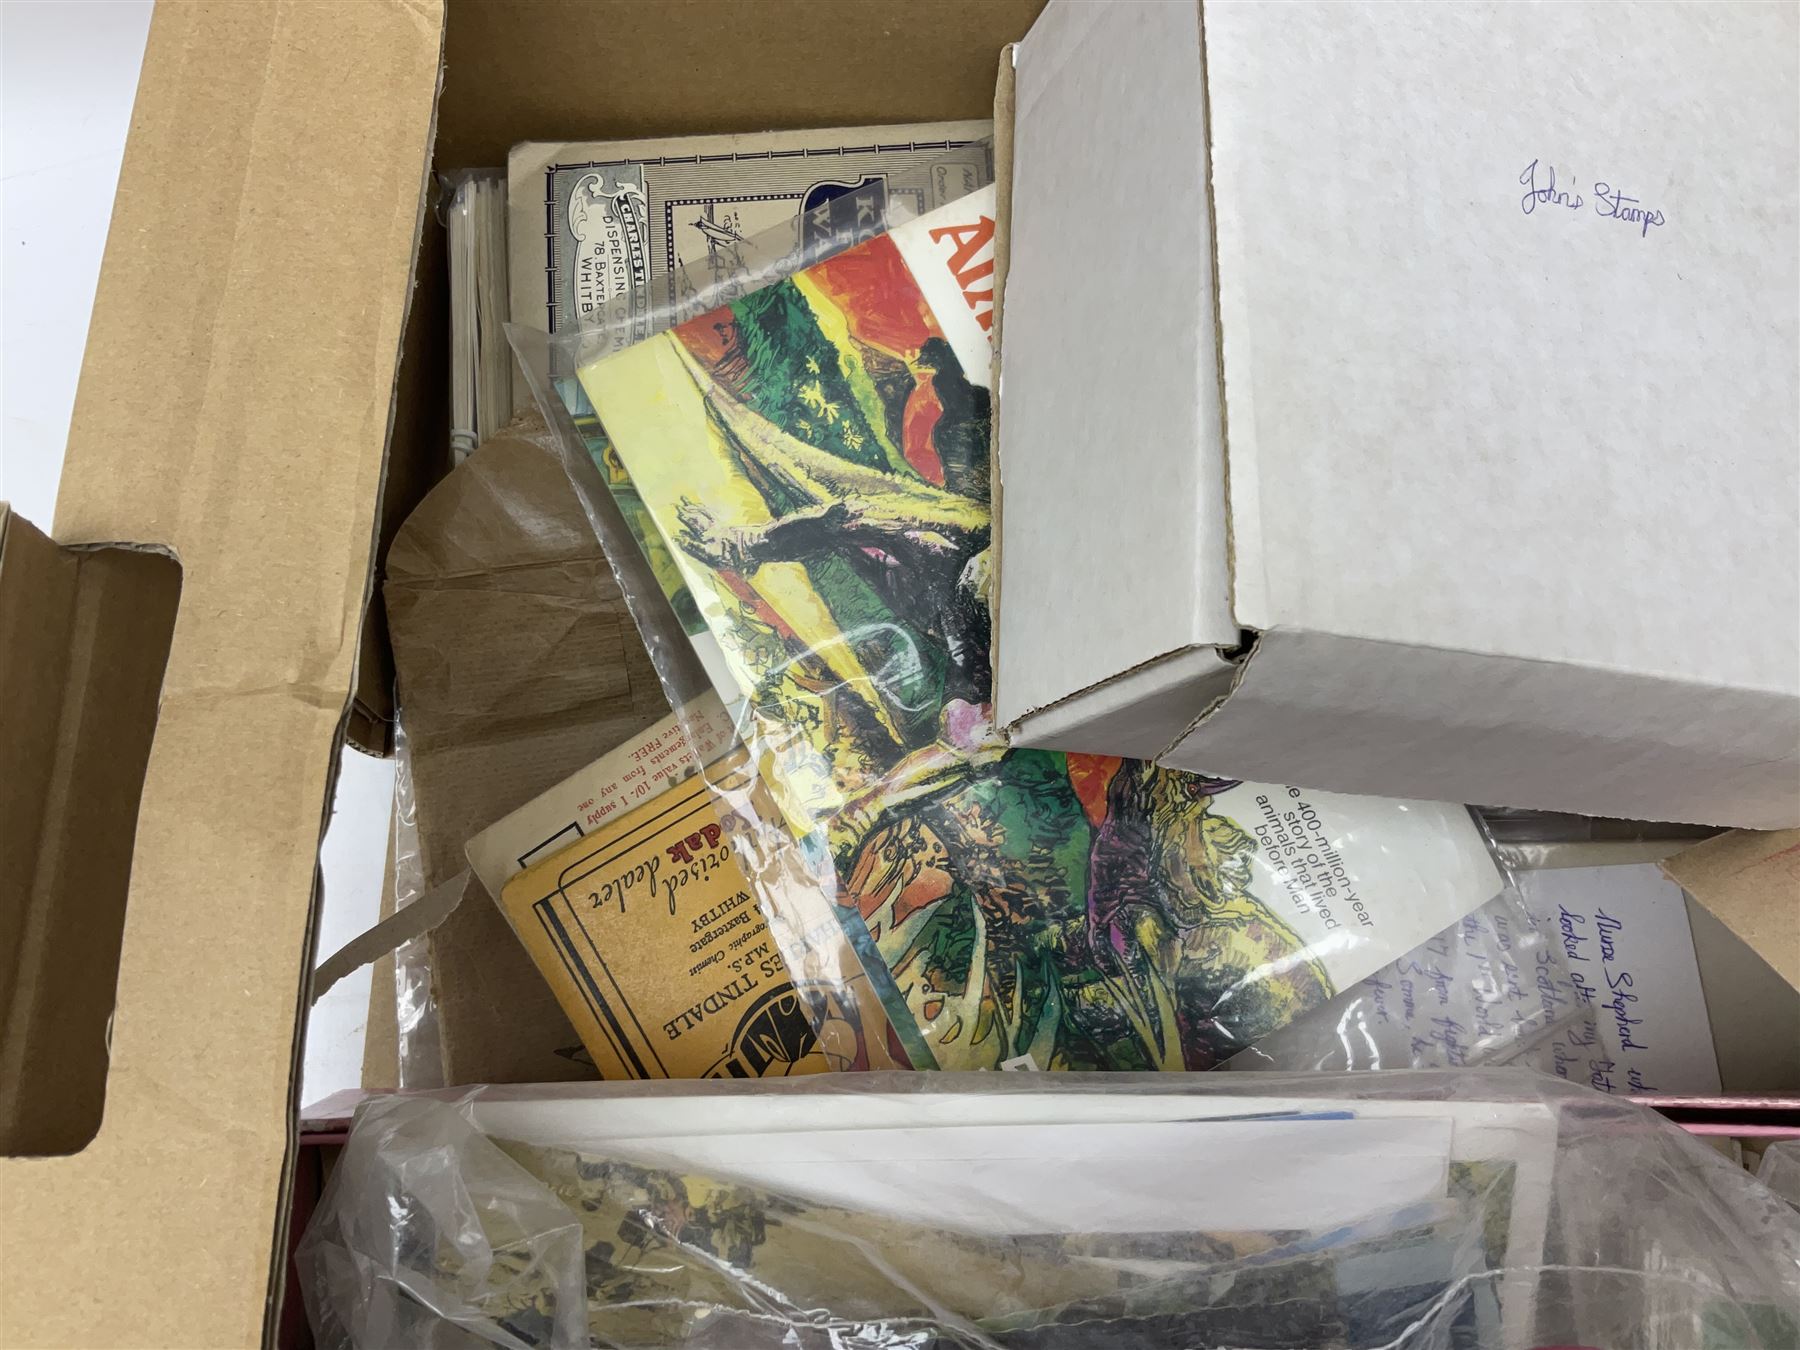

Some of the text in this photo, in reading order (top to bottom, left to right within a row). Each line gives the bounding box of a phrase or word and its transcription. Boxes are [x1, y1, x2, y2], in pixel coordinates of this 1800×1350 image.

[1519, 158, 1666, 238] John's Stamps
[602, 215, 625, 300] DISPENSING
[620, 202, 644, 268] CHARLES
[580, 257, 595, 327] WHITBY
[622, 765, 648, 783] from
[627, 738, 662, 762] FREE.
[651, 763, 678, 782] value
[576, 797, 595, 812] one
[586, 801, 617, 826] supply
[600, 782, 618, 798] any
[1253, 823, 1290, 876] before
[1255, 794, 1342, 931] animals that lived
[1283, 810, 1338, 898] story of the
[1297, 801, 1375, 929] 400-million-year
[588, 855, 661, 914] dealer
[690, 890, 751, 934] WHITBY
[689, 909, 752, 954] Baxtergate
[727, 942, 770, 974] M.P.S.
[1558, 903, 1591, 962] looked
[662, 972, 759, 1041] TINDALE
[1601, 966, 1649, 1052] Shepherd
